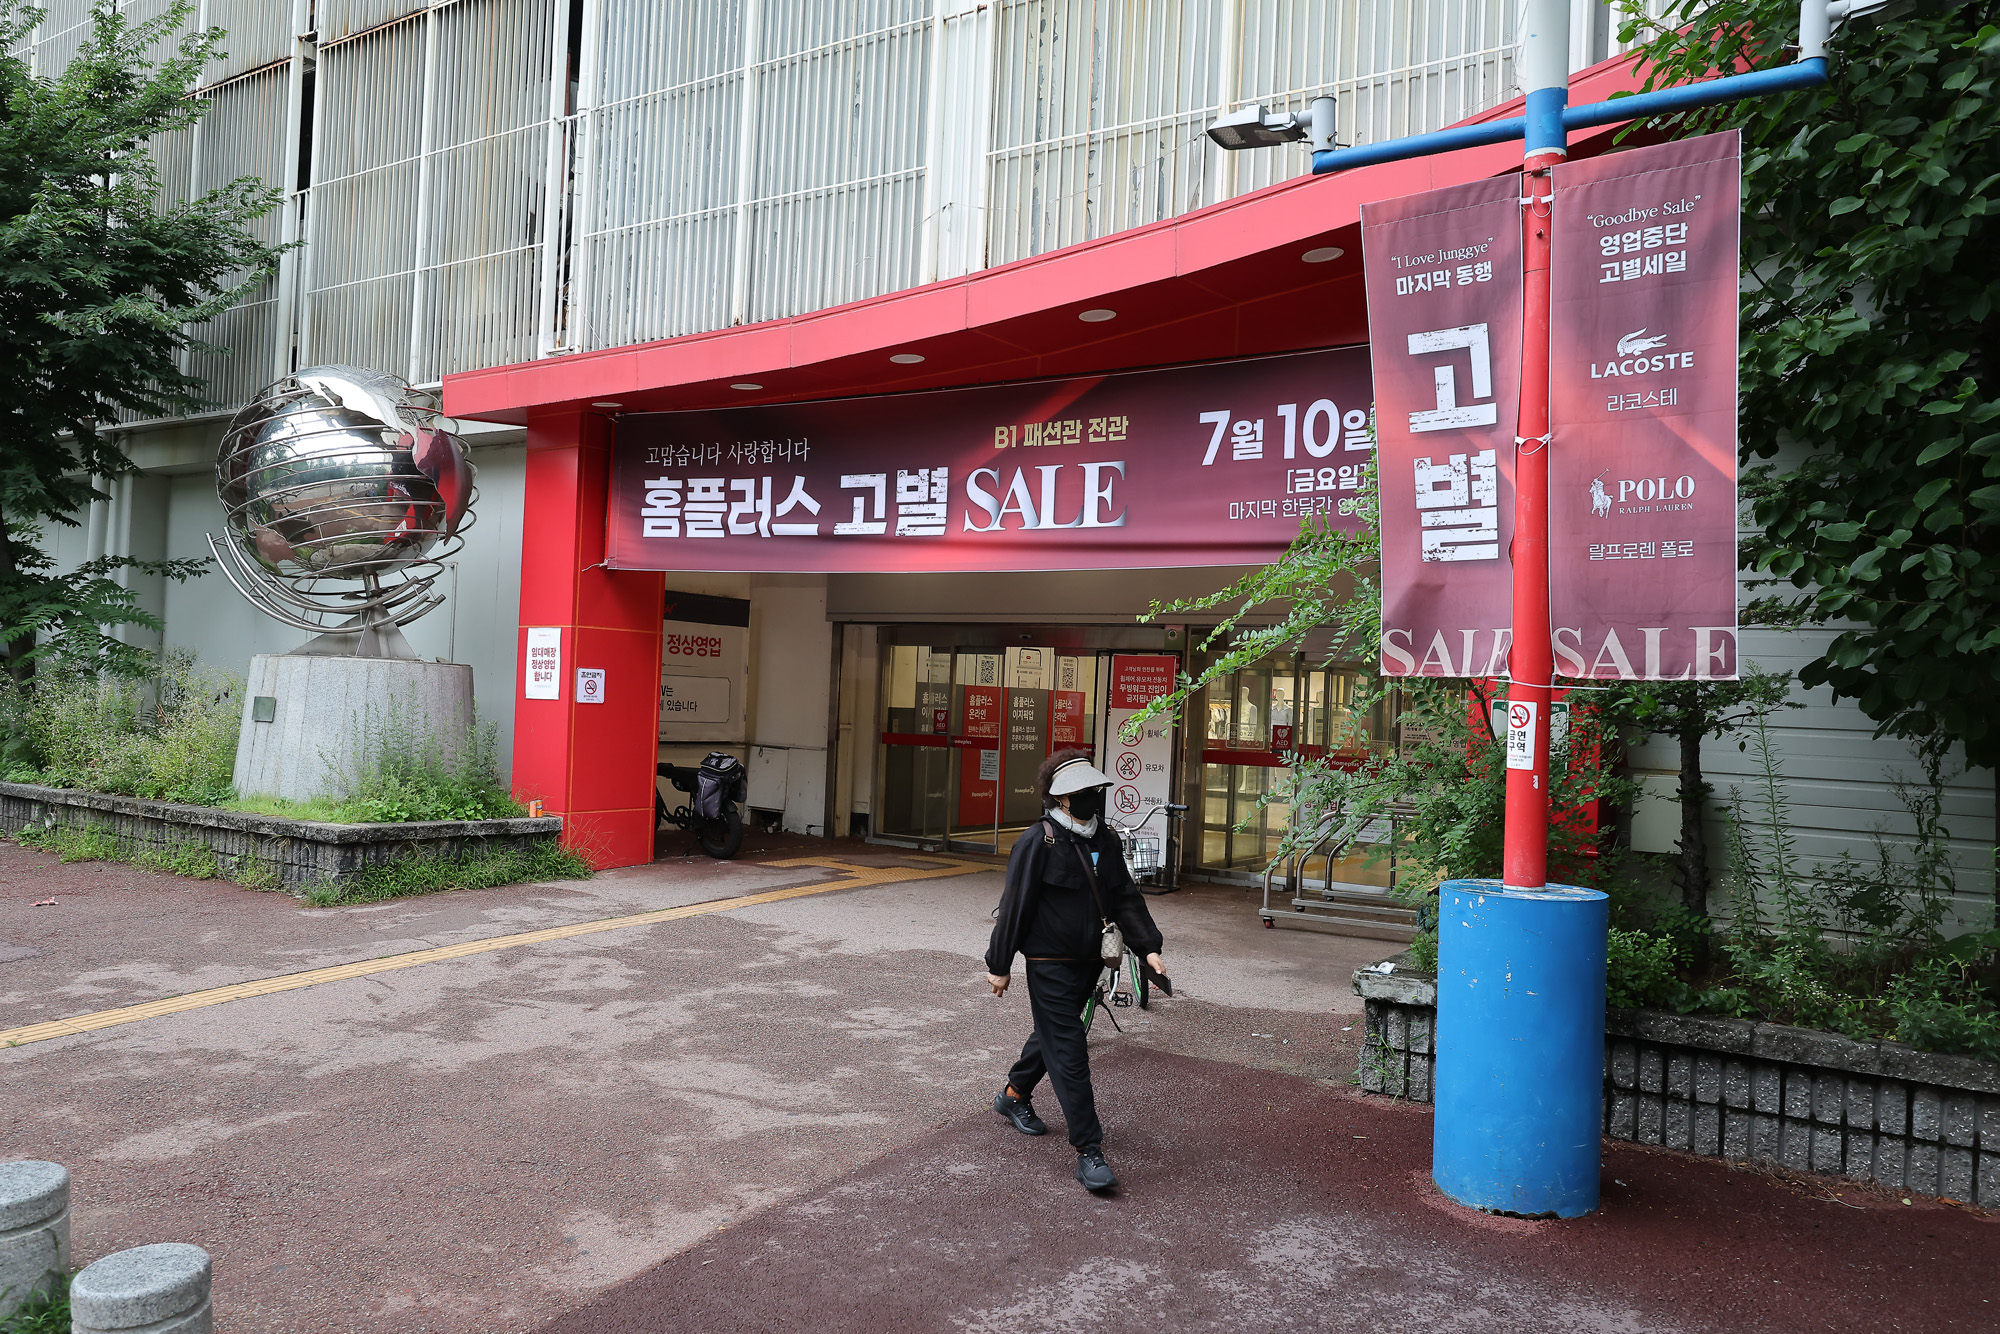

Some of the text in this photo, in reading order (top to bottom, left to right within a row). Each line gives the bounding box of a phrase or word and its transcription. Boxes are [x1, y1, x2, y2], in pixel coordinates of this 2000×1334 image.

[1587, 194, 1701, 228] “Goodbye Sale”
[1599, 222, 1688, 257] 영업중단
[1405, 253, 1435, 268] Love
[1599, 250, 1687, 284] 고별세일
[1396, 260, 1493, 296] 마지막 동행
[1590, 351, 1694, 379] LACOSTE
[1607, 387, 1677, 412] 라코스테
[994, 415, 1129, 449] B1 패션관 전관
[1199, 398, 1376, 466] 7월 10일
[1408, 322, 1499, 563] 고별
[645, 437, 811, 467] 고맙습니다 사랑합니다
[641, 460, 1128, 538] 홈플러스 고별 SALE
[1617, 475, 1695, 503] POLO
[1229, 499, 1277, 520] 마지막
[1282, 496, 1333, 517] 한달간
[1619, 502, 1694, 514] RALPH LAUREN
[1589, 540, 1694, 561] 랄프로렌 폴로
[531, 647, 557, 658] 임대매장
[667, 634, 722, 657] 정상영업
[1381, 628, 1512, 677] SALE
[1552, 626, 1738, 680] SALE
[531, 659, 556, 670] 정상영업
[534, 671, 553, 682] 합니다
[1119, 683, 1167, 694] 무빙워크 진입이
[667, 700, 698, 712] 있습니다
[969, 694, 993, 706] 홈플러스
[1013, 696, 1035, 708] 홈플러스
[969, 708, 987, 720] 온라인
[1012, 709, 1034, 721] 이지픽업
[1509, 729, 1526, 741] 금연
[1509, 741, 1526, 753] 구역
[1145, 763, 1165, 773] 유모차
[1331, 759, 1360, 767] Homeplus
[1144, 796, 1163, 806] 전동차
